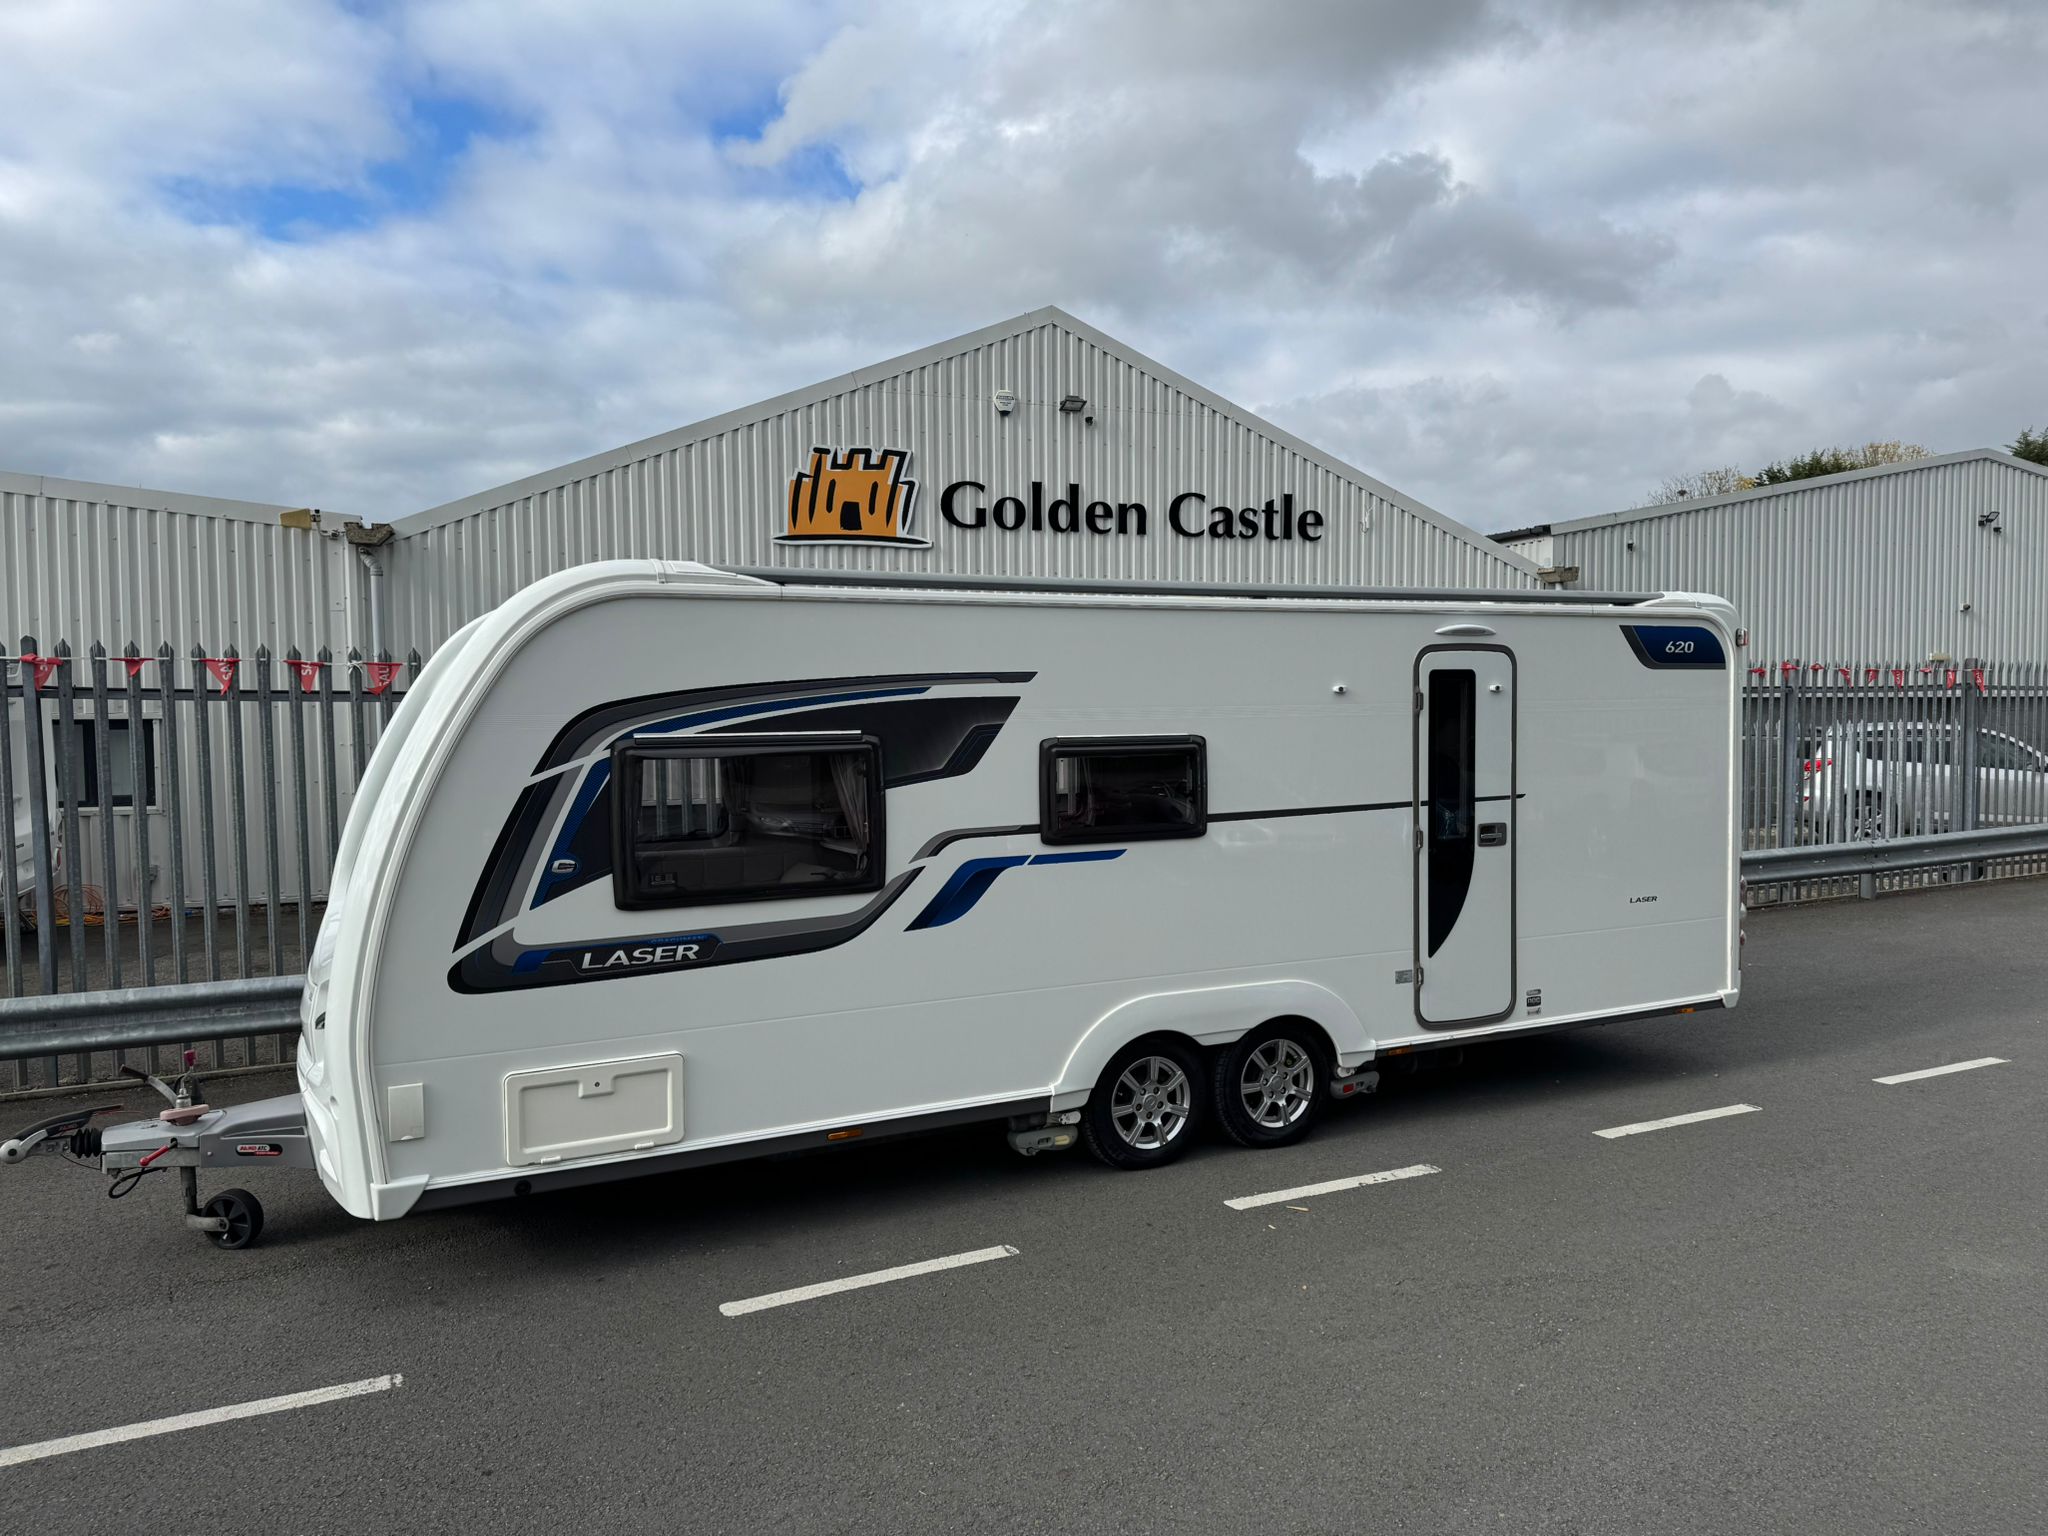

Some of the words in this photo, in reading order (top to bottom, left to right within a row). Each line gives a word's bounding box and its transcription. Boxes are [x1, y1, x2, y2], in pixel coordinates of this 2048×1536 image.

[941, 481, 1147, 536] Golden
[1168, 492, 1324, 542] Castle
[1665, 640, 1695, 653] 620
[1629, 895, 1658, 904] LASER
[582, 944, 700, 969] LASER
